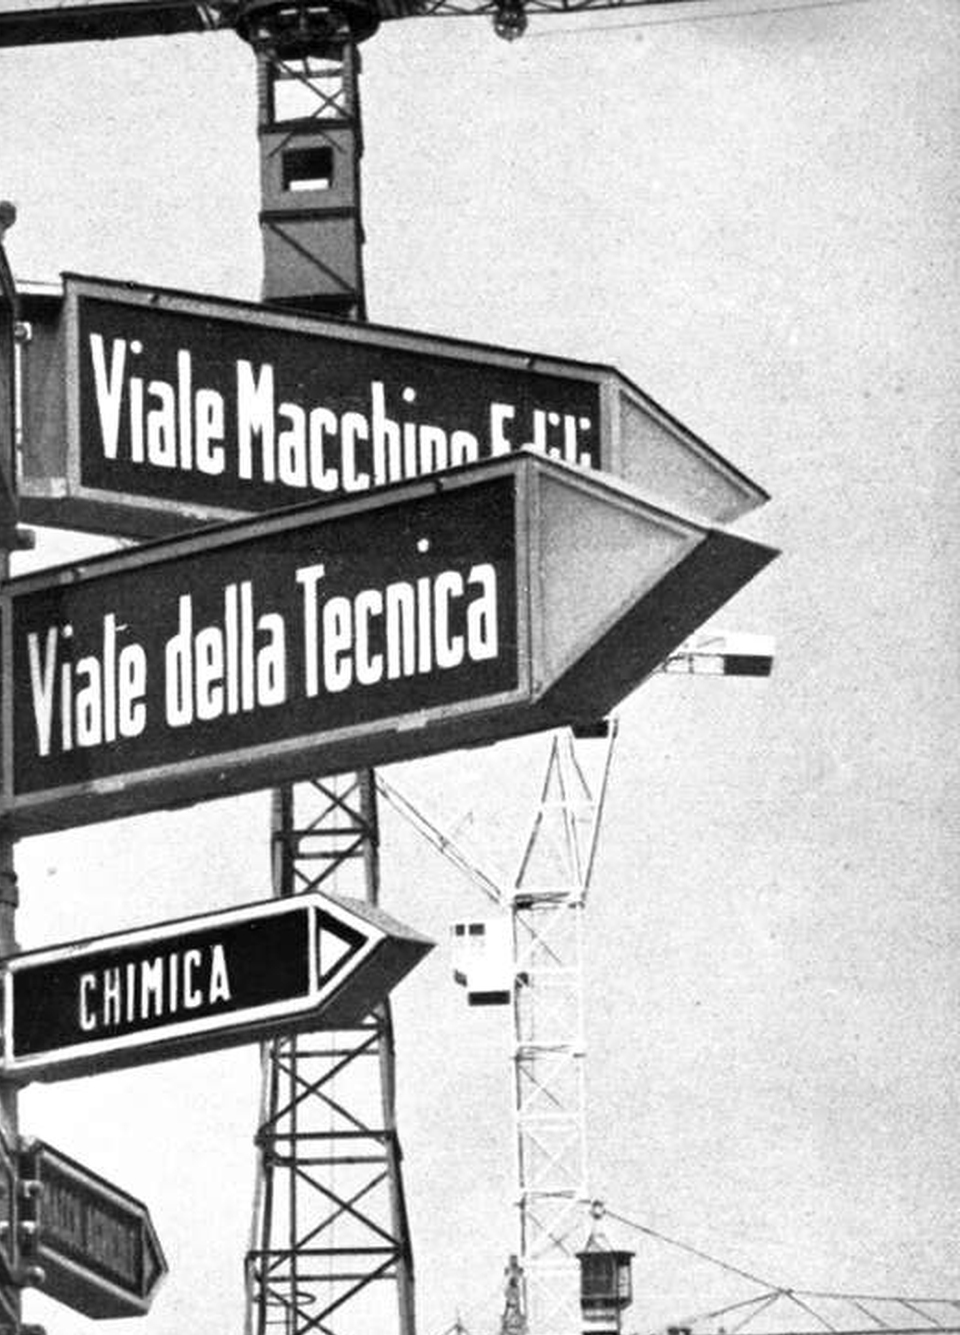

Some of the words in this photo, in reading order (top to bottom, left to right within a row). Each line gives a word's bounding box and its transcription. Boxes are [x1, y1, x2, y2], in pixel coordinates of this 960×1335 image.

[90, 334, 226, 475] Viale
[28, 613, 147, 757] Viale
[165, 581, 287, 727] della
[296, 538, 499, 698] Tecnica
[79, 944, 232, 1032] CHIMICA
